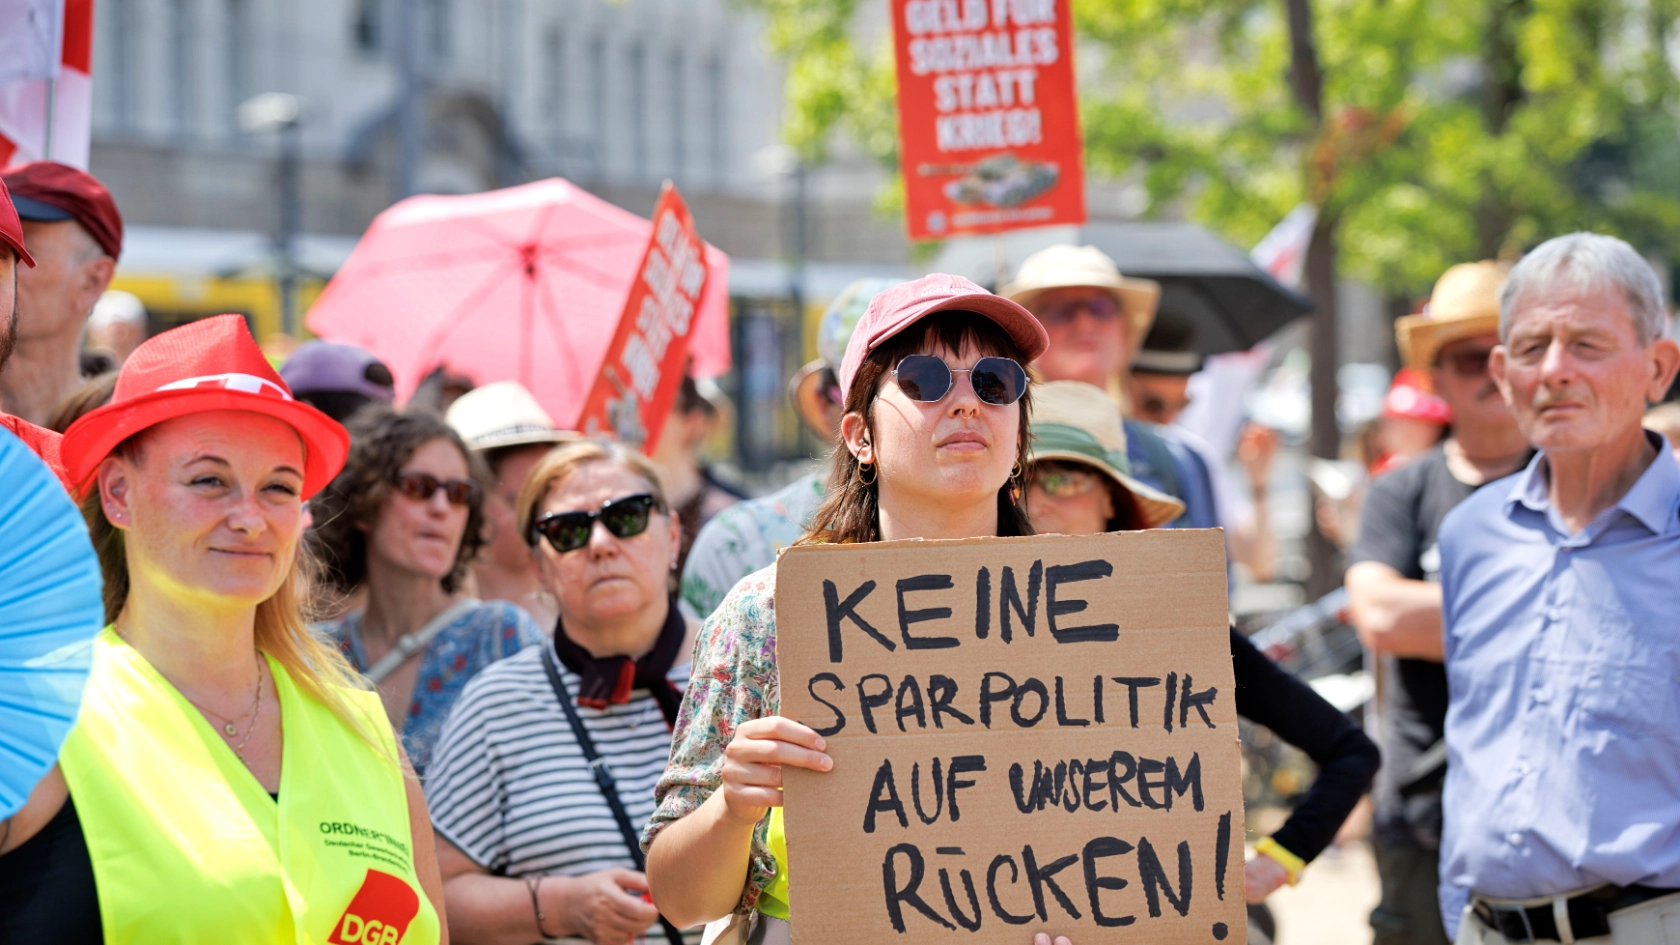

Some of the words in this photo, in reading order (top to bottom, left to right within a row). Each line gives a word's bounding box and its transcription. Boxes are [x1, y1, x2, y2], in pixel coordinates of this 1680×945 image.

[905, 0, 988, 35] GELD
[908, 27, 1059, 76] SOZIALES
[933, 68, 1038, 112] STATT
[936, 108, 1043, 151] KRIEG!
[822, 558, 1120, 663] KEINE
[799, 670, 1218, 737] SPARPOLITIK
[862, 754, 988, 833] AUF
[1008, 750, 1205, 813] UNSEREM
[339, 912, 399, 945] DGB
